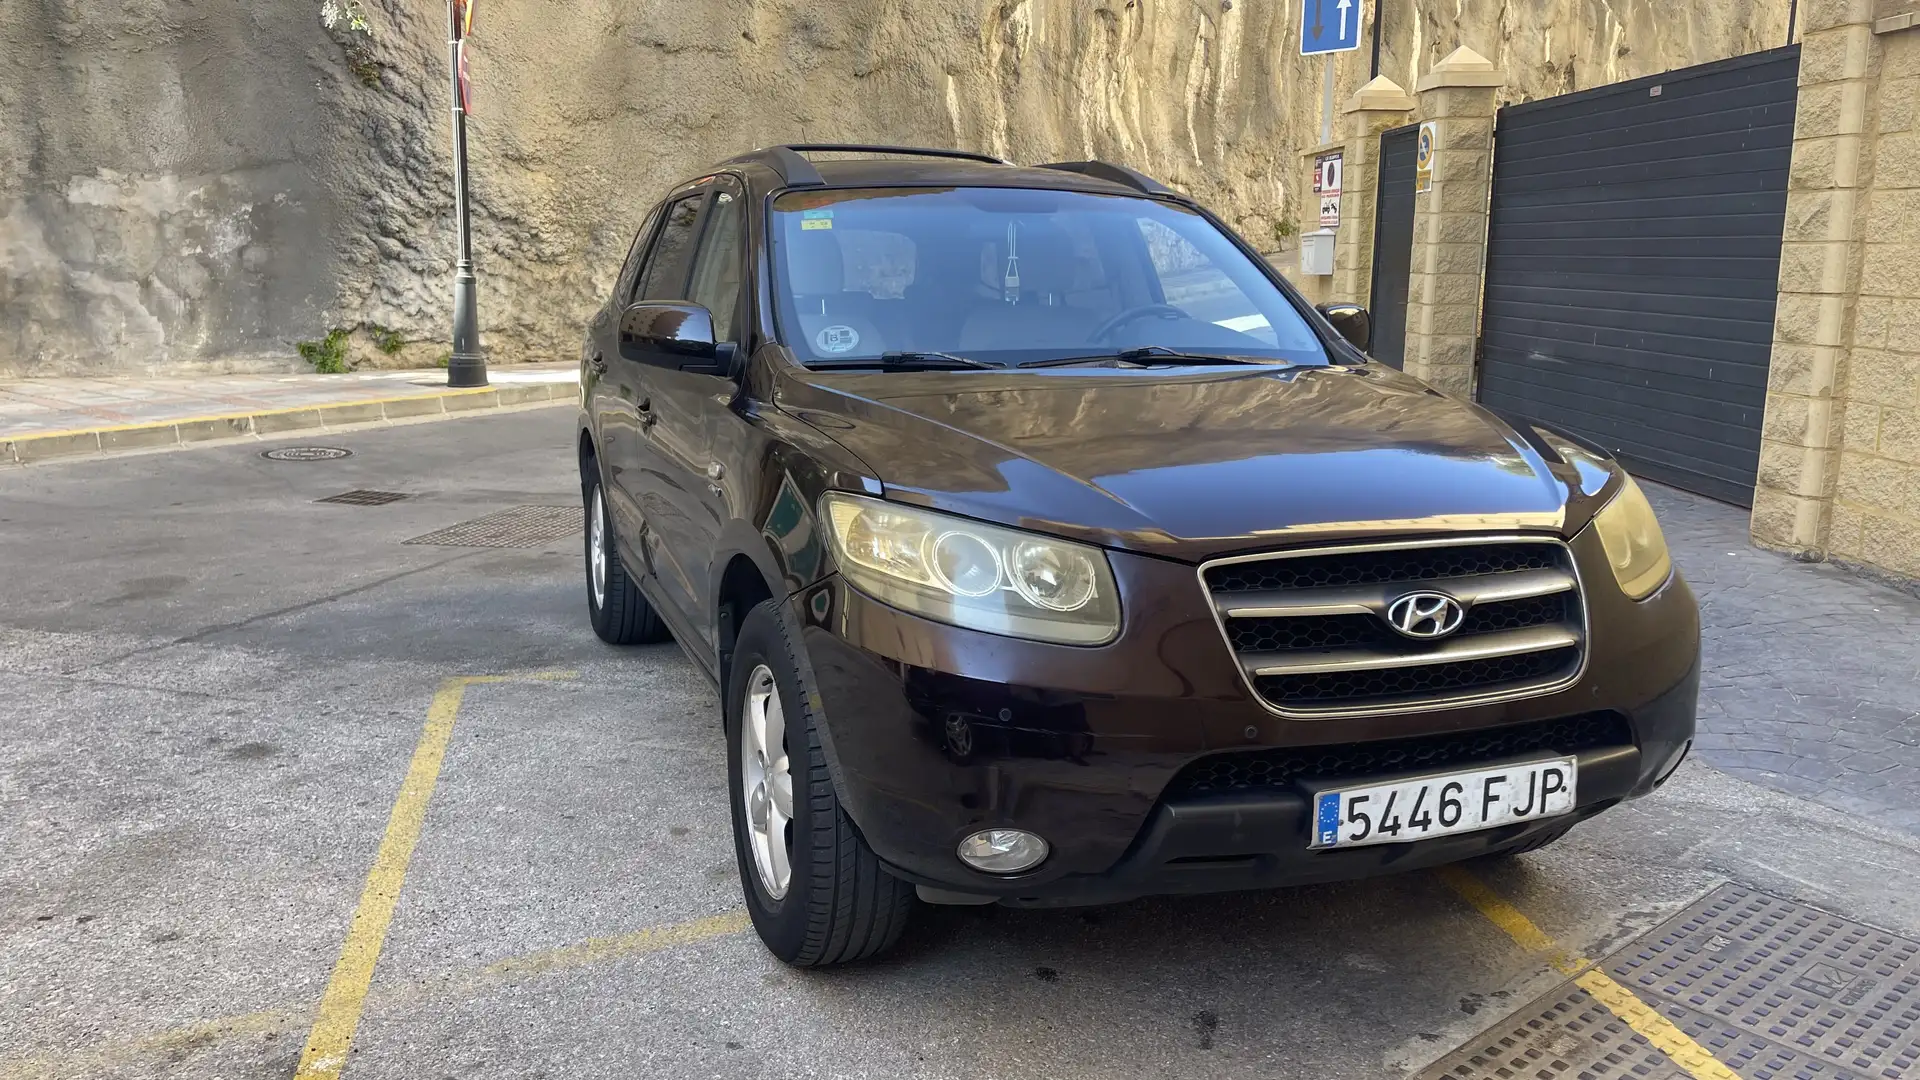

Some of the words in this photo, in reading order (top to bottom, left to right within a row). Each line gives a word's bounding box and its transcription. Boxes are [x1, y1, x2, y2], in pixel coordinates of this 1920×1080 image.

[1347, 781, 1463, 841] 5446
[1481, 768, 1564, 822] FJP
[1322, 830, 1333, 844] E
